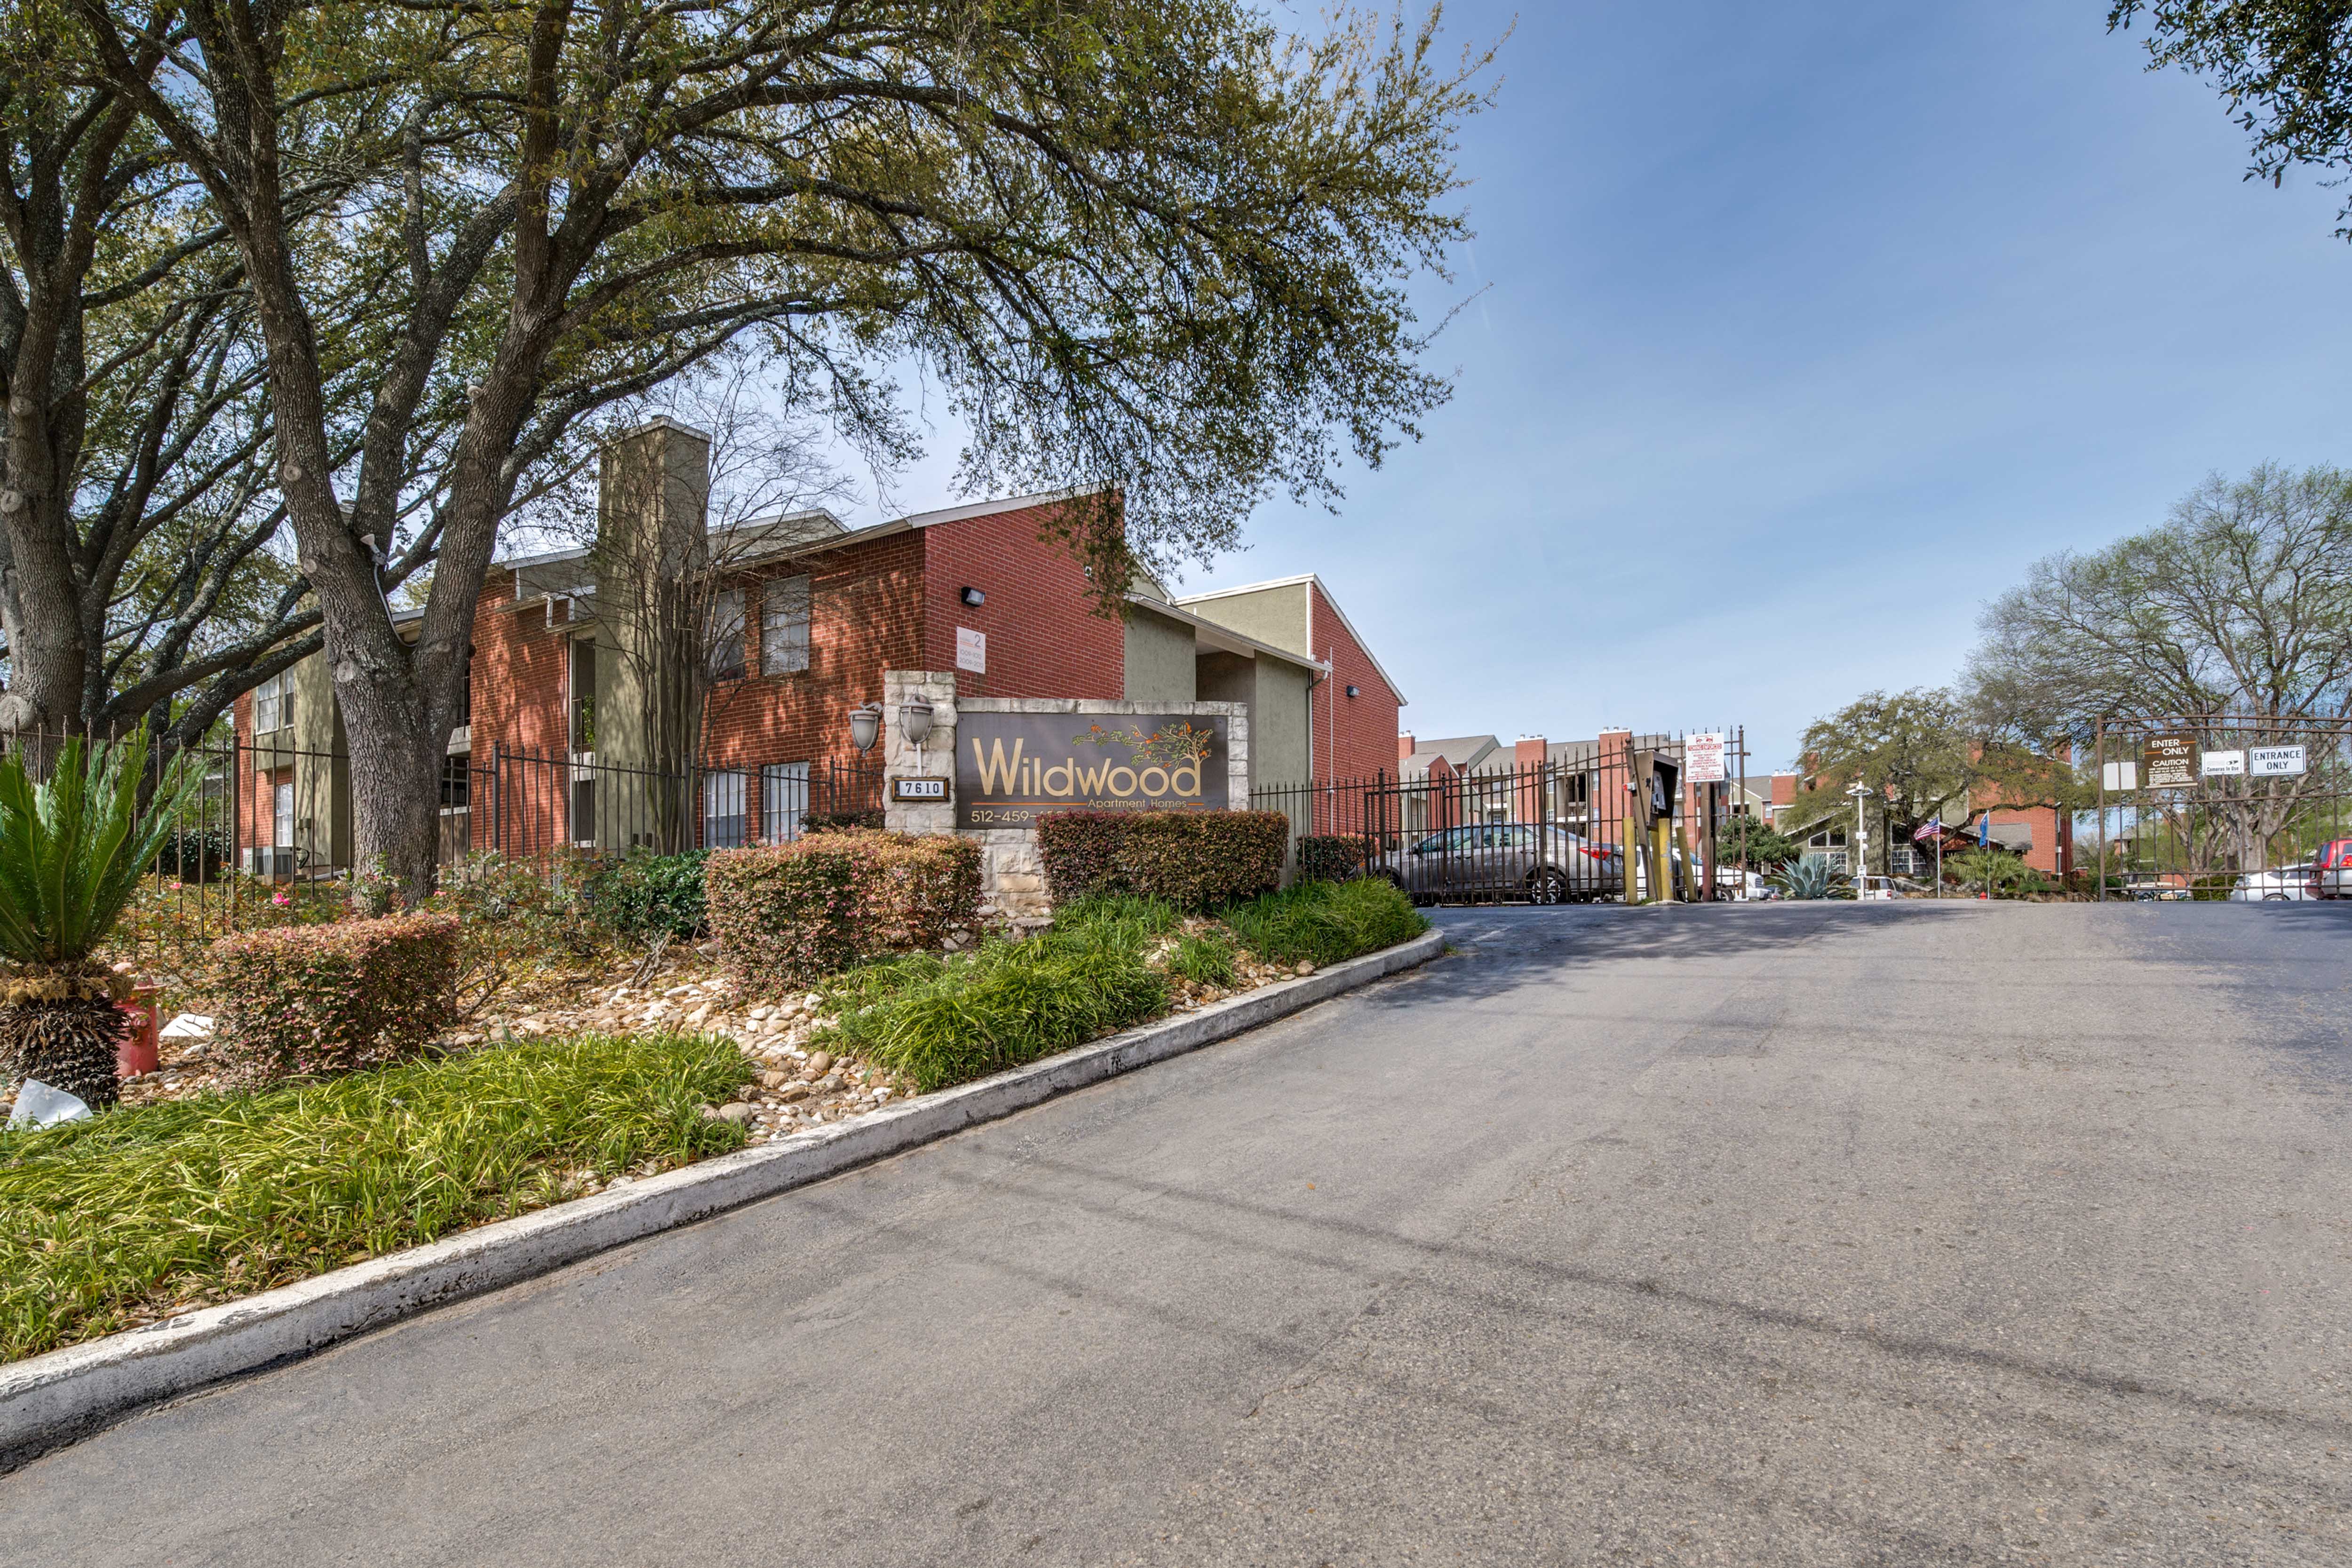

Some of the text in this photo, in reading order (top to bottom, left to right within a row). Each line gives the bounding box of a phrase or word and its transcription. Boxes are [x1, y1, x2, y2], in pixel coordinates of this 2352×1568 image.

[975, 634, 981, 648] 2
[959, 657, 984, 669] 2009-2012
[2152, 739, 2180, 748] ENTER
[2162, 746, 2189, 756] ONLY
[2254, 750, 2301, 761] ENTRANCE
[971, 737, 1201, 796] Wildwood
[2153, 758, 2189, 767] CAUTION
[2266, 761, 2288, 770] ONLY
[906, 782, 939, 794] 7610
[1087, 799, 1187, 809] Apartment Homes
[971, 810, 1063, 822] 512-459-
